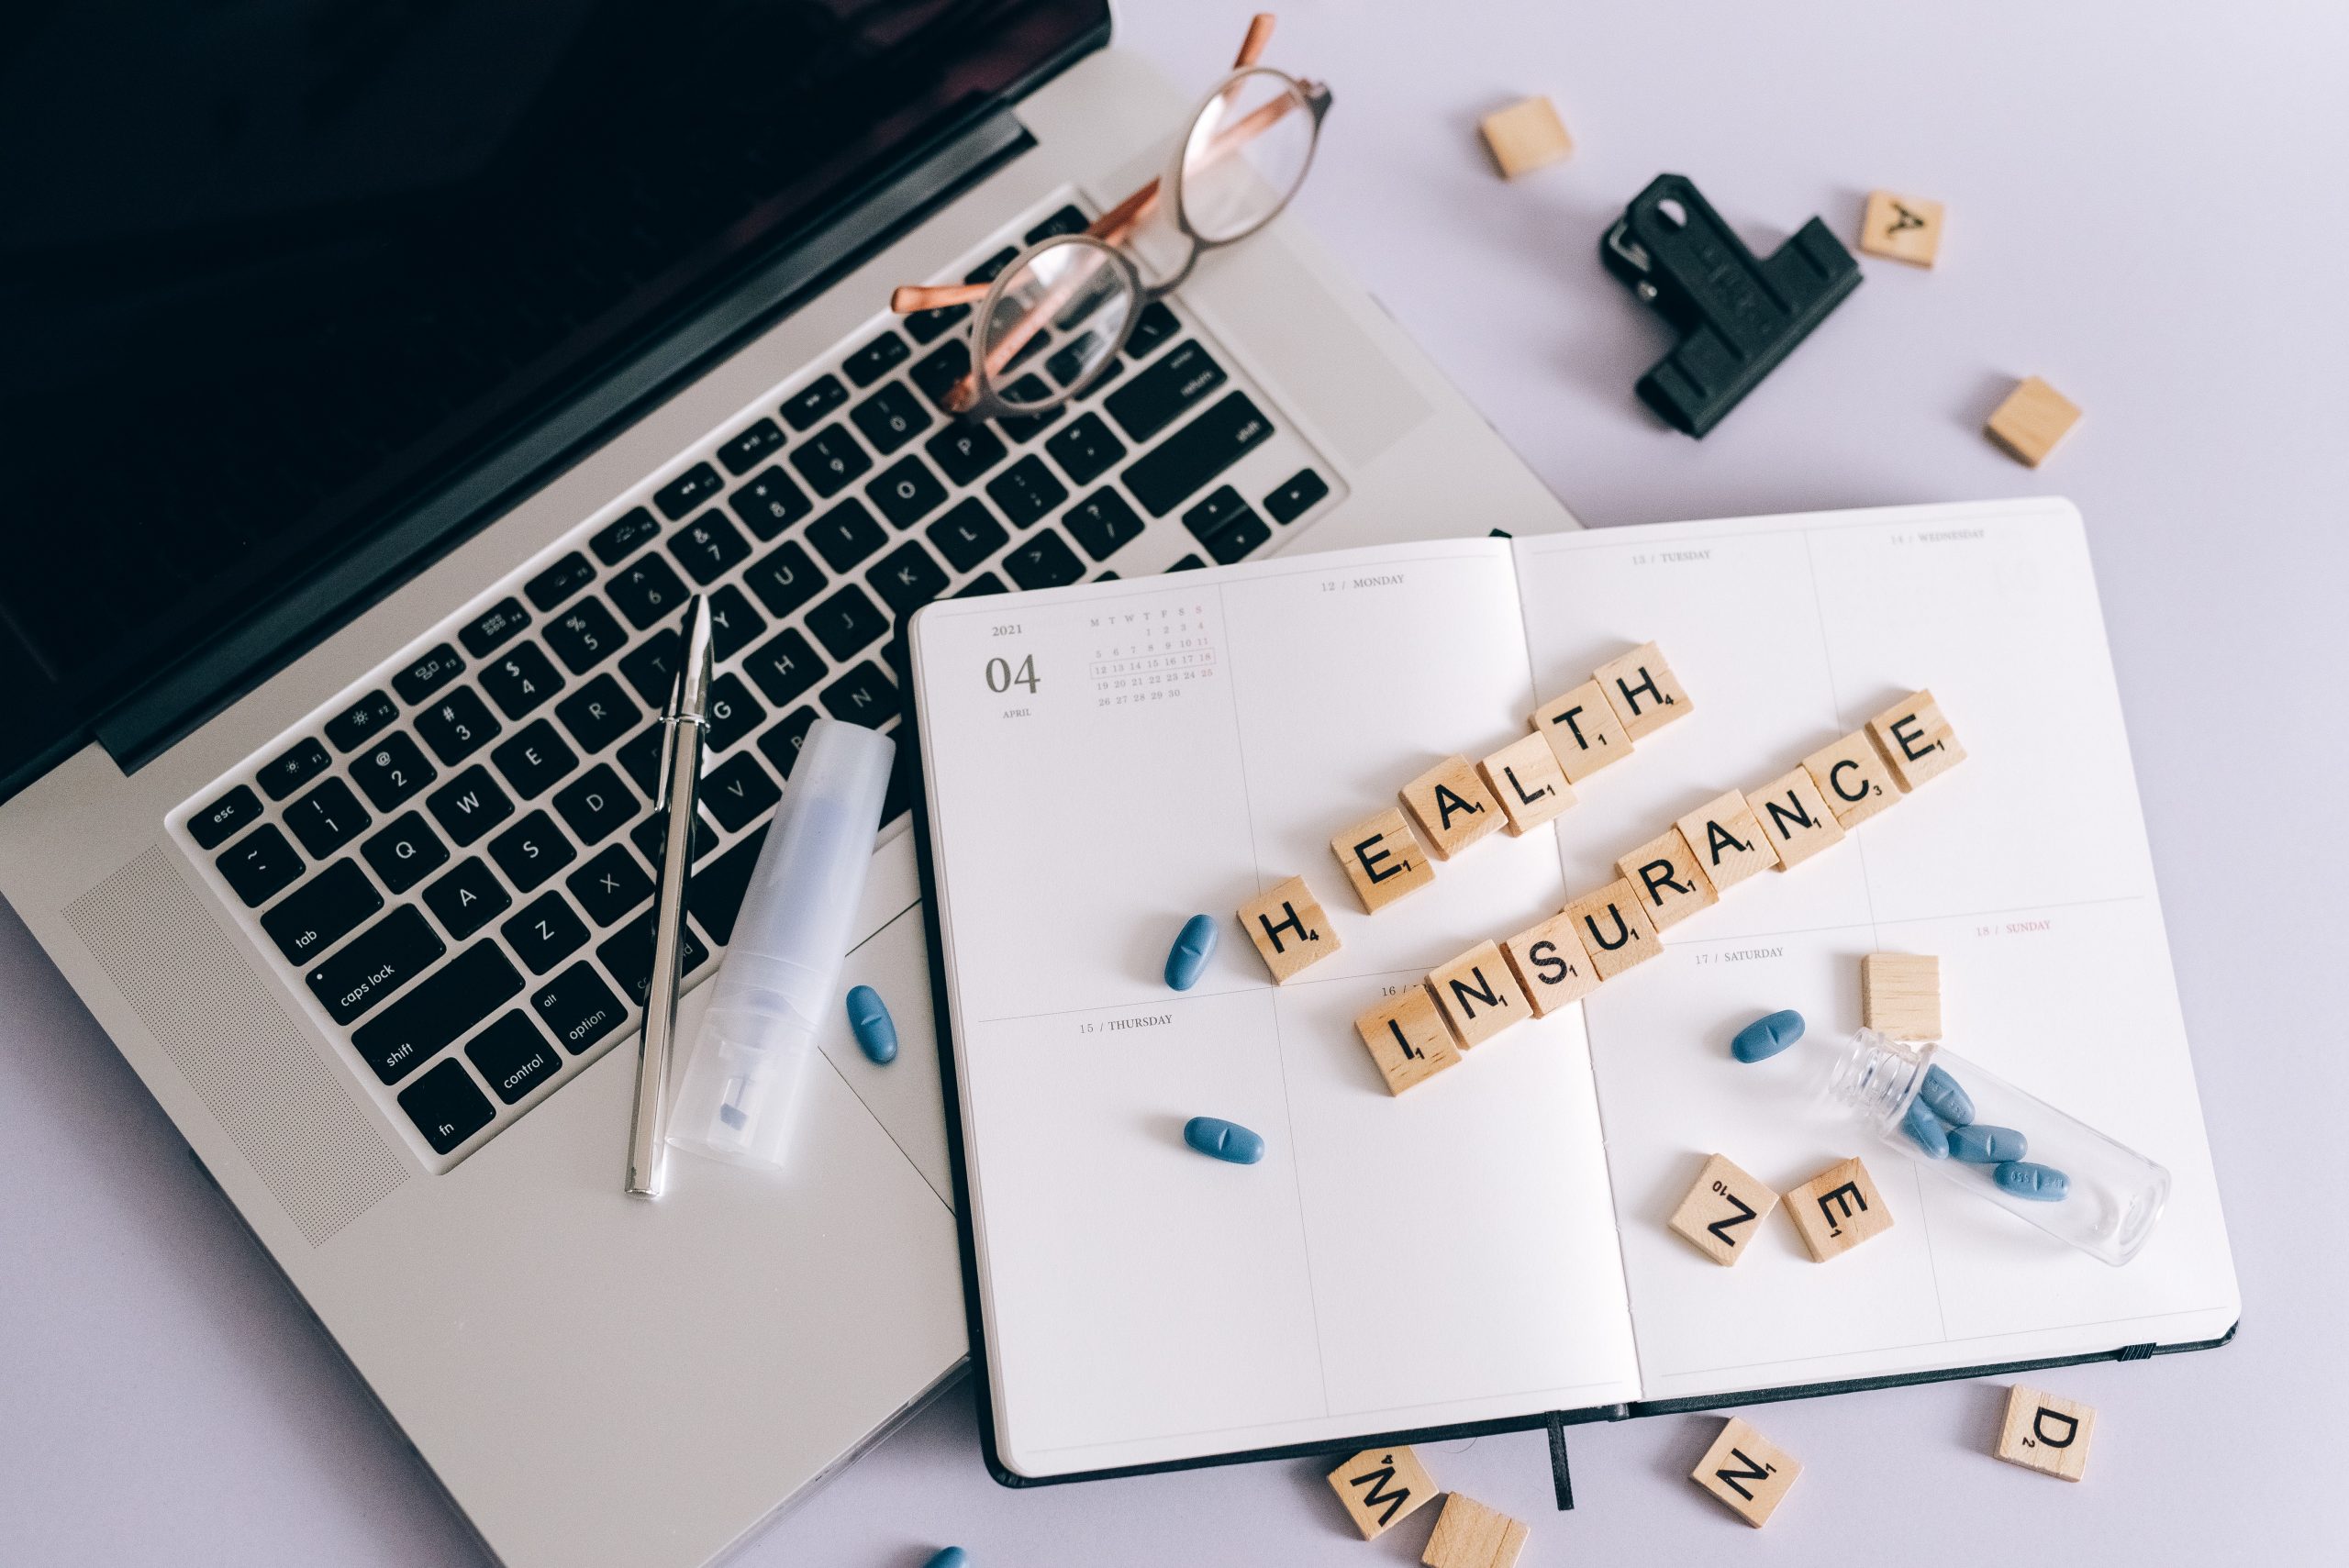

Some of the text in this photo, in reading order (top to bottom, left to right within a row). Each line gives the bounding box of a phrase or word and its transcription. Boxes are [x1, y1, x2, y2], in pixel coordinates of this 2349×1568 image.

[1887, 200, 1925, 240] A
[959, 527, 977, 541] L
[1661, 550, 1711, 563] TUESDAY
[774, 566, 794, 585] U
[897, 567, 917, 585] K
[1320, 582, 1336, 593] 12
[1353, 574, 1404, 590] MONDAY
[648, 590, 662, 604] 6
[713, 611, 729, 628] Y
[842, 613, 854, 628] J
[993, 625, 1022, 637] 2021
[584, 634, 597, 651] 5
[774, 655, 794, 675] H
[985, 653, 1041, 694] 04
[522, 679, 535, 695] 4
[852, 688, 873, 708] N
[1099, 698, 1110, 706] 26
[1116, 696, 1127, 705] 27
[1133, 694, 1145, 702] 28
[1151, 692, 1163, 700] 29
[442, 706, 455, 722] #
[589, 703, 607, 719] R
[713, 701, 731, 718] G
[1003, 708, 1031, 719] APRIL
[456, 725, 471, 740] 3
[376, 751, 391, 766] @
[525, 748, 542, 766] E
[392, 771, 406, 786] 2
[728, 781, 744, 797] V
[457, 791, 480, 814] W
[586, 794, 604, 812] D
[213, 805, 235, 823] esc
[325, 818, 339, 832] 1
[395, 841, 416, 859] Q
[523, 840, 540, 858] S
[599, 873, 620, 894] X
[458, 888, 477, 906] A
[535, 919, 555, 940] Z
[2006, 920, 2052, 934] SUNDAY
[295, 929, 317, 949] tab
[1696, 953, 1709, 965] 17
[1724, 947, 1784, 963] SATURDAY
[340, 963, 395, 1006] caps lock
[1382, 985, 1396, 995] 16
[543, 993, 558, 1007] alt
[568, 1009, 606, 1041] option
[1079, 1023, 1095, 1034] 15
[1108, 1014, 1174, 1031] THURSDAY
[386, 1042, 414, 1067] shift
[503, 1053, 544, 1090] control
[439, 1121, 454, 1137] fn
[1817, 1181, 1868, 1229] E
[2033, 1407, 2078, 1448] D
